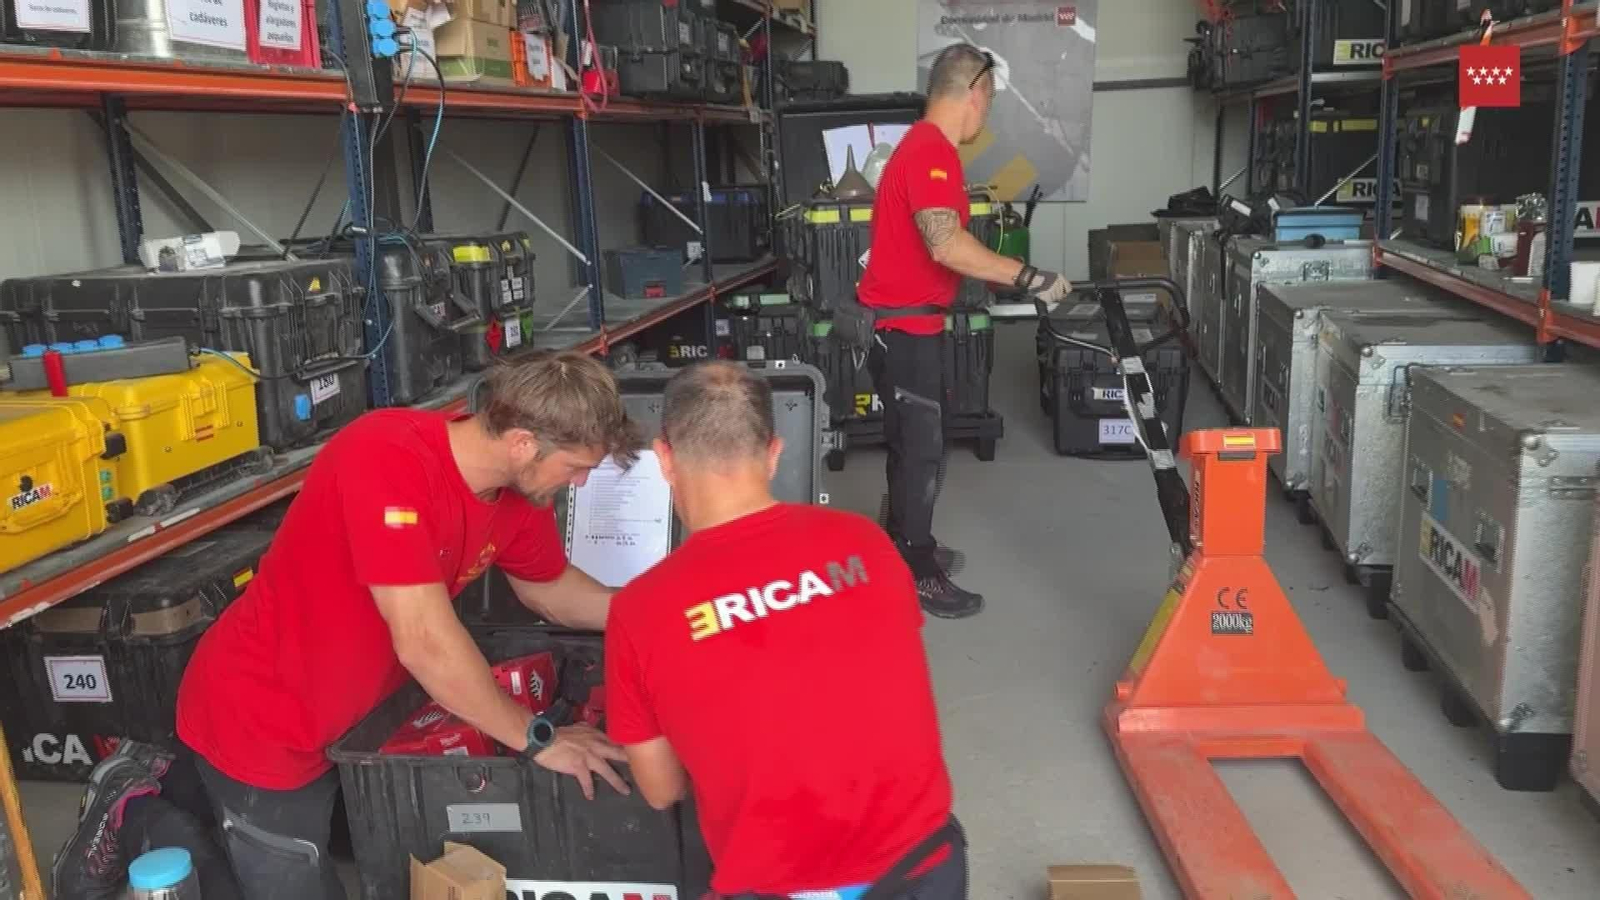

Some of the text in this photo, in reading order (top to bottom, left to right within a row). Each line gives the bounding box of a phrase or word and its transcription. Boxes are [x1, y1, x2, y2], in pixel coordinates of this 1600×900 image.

[1103, 425, 1131, 435] 317C
[1212, 612, 1253, 634] 2000kg
[63, 673, 97, 690] 240
[461, 812, 491, 826] 239
